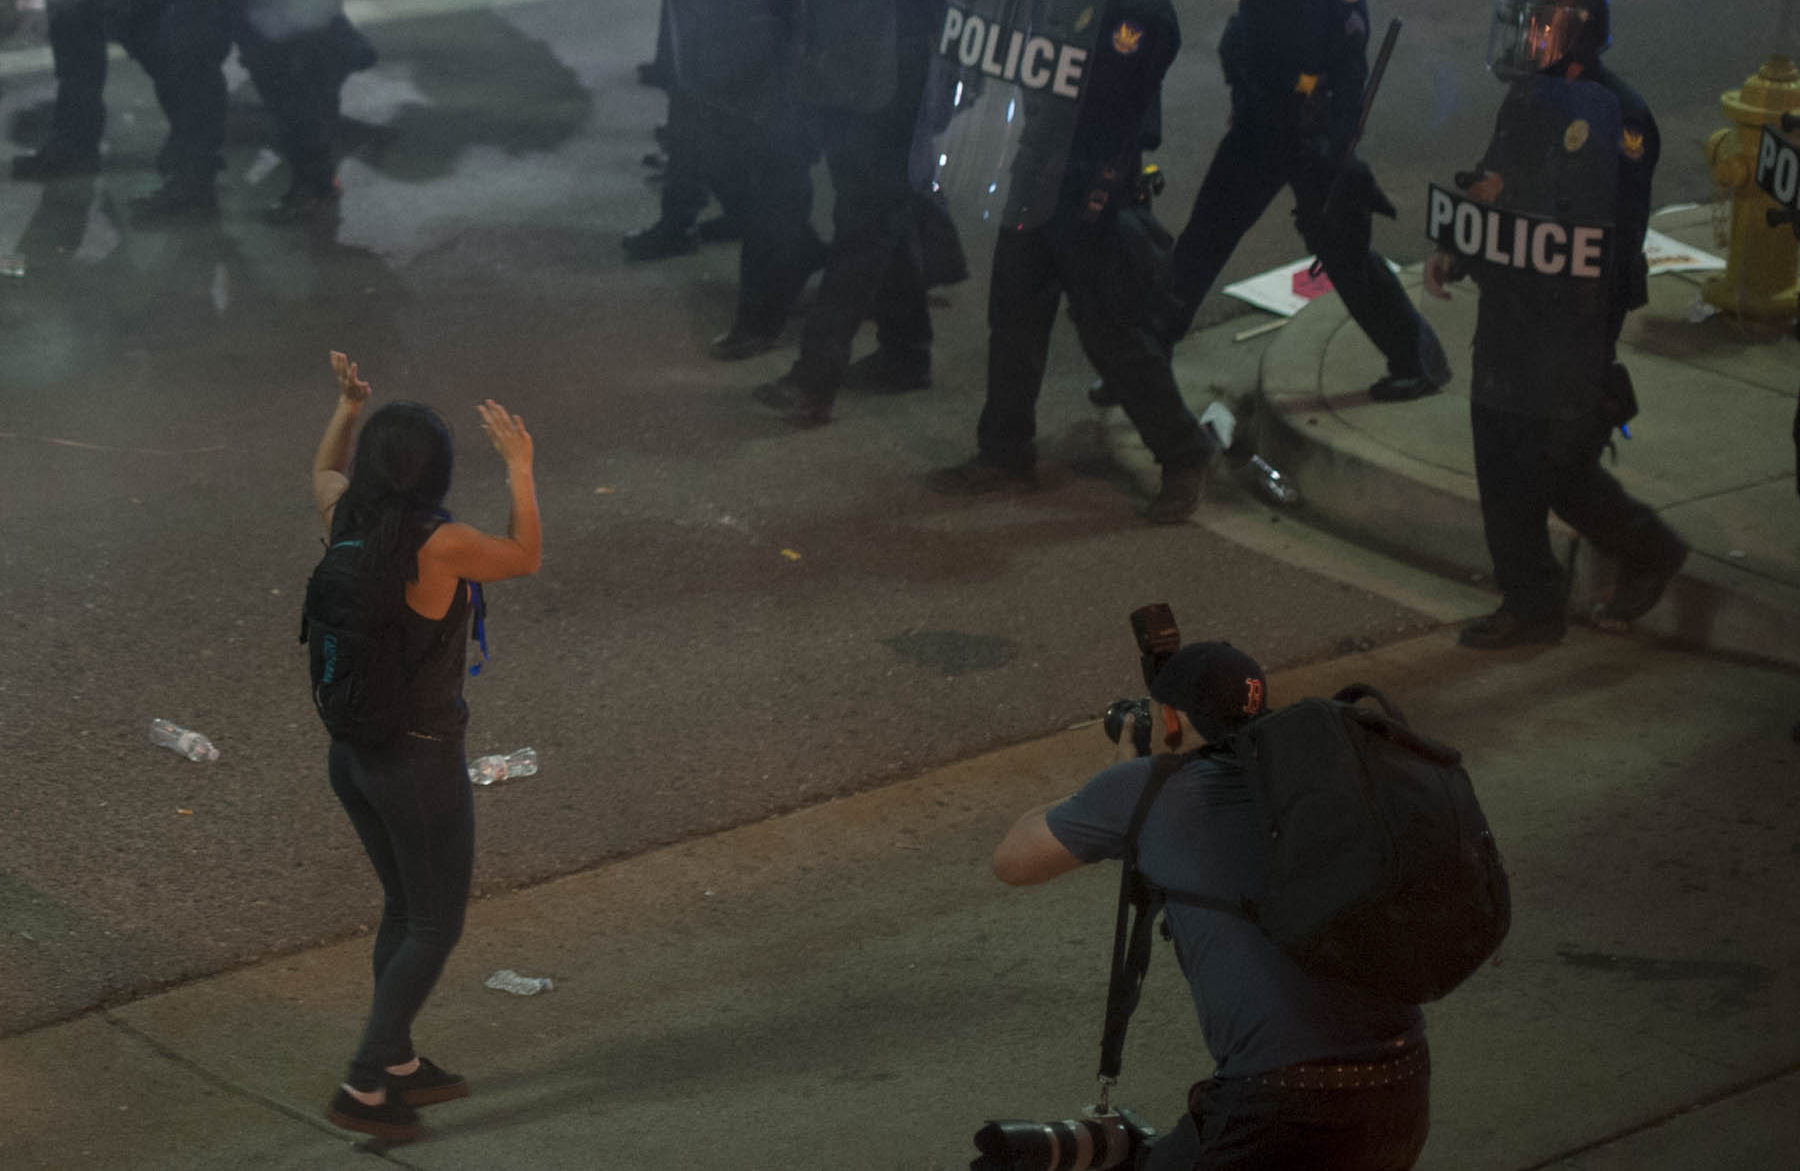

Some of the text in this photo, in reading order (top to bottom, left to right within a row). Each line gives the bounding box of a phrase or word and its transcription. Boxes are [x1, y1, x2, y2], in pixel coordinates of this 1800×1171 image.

[938, 5, 1088, 99] POLICE
[1758, 132, 1800, 203] PO
[1430, 189, 1605, 278] POLICE
